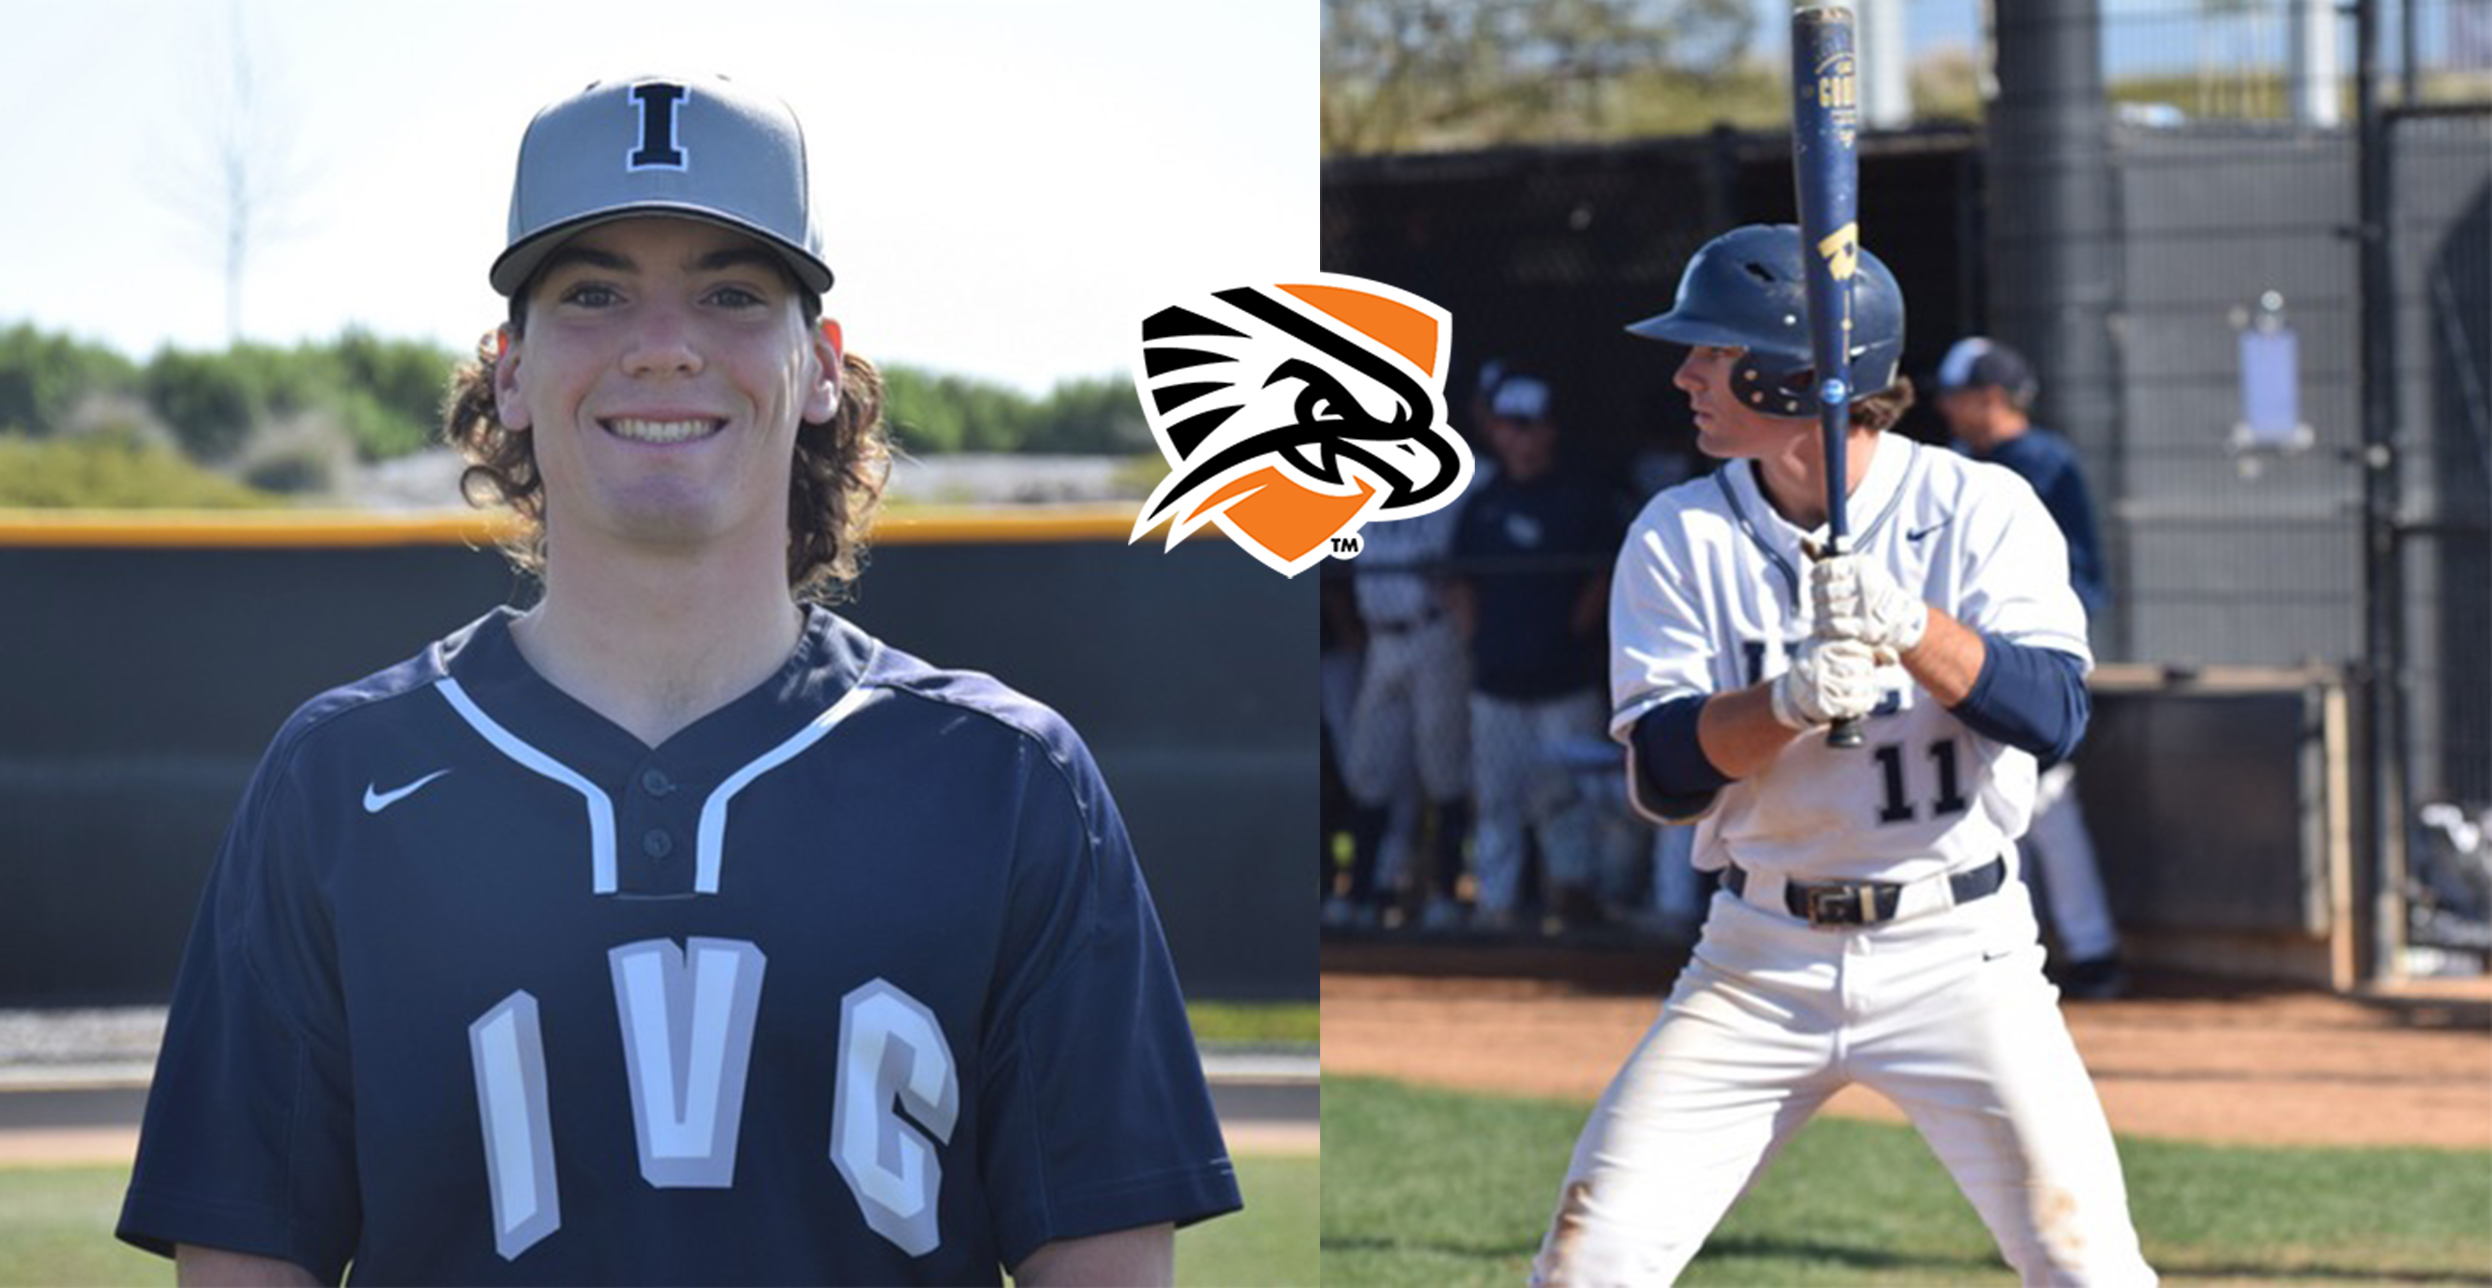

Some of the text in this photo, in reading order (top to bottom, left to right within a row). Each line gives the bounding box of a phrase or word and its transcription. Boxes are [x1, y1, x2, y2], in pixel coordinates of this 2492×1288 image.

[627, 82, 689, 172] I
[1874, 740, 1966, 823] 11
[468, 936, 960, 1262] IVC
